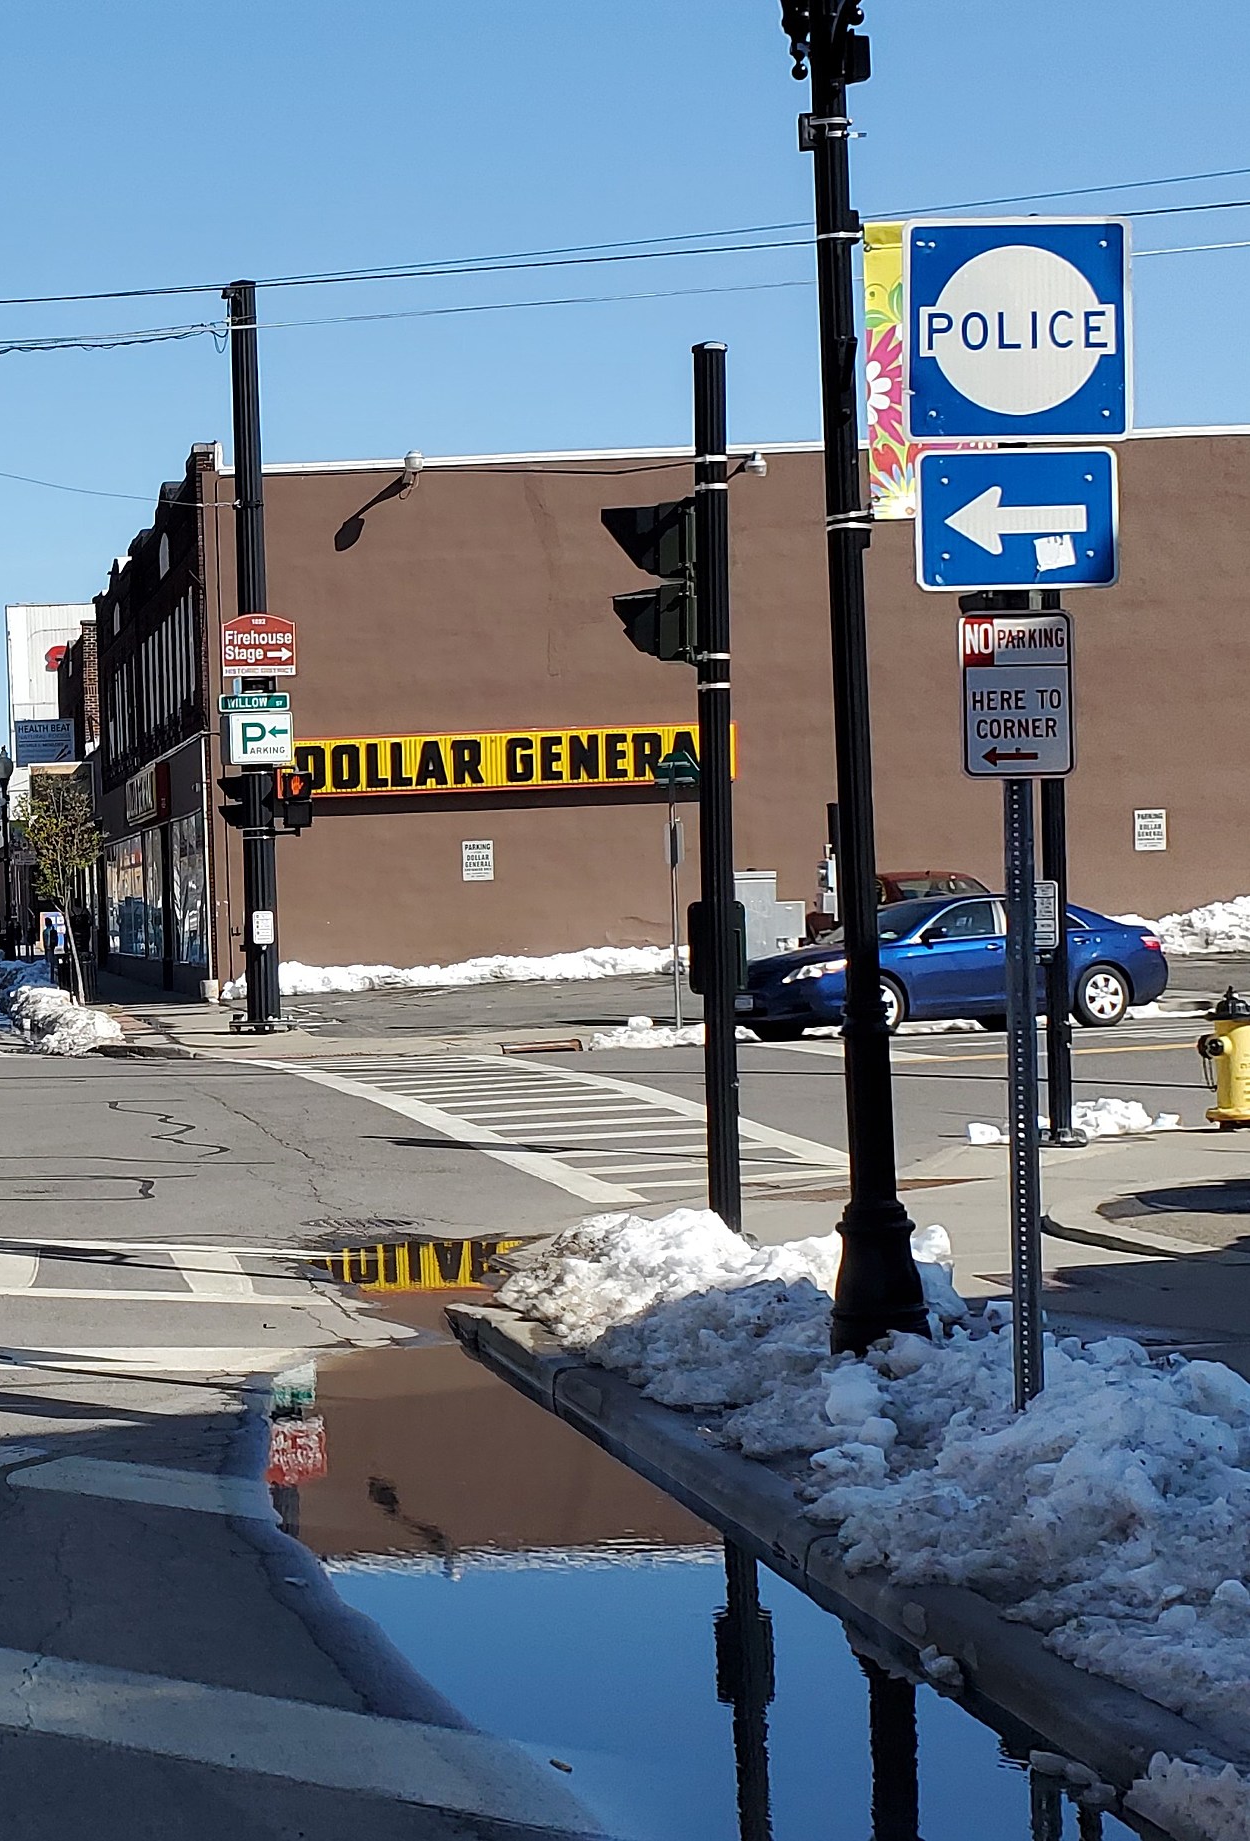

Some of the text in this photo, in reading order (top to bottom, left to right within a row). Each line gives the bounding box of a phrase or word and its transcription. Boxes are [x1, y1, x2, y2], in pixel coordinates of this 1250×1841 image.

[927, 310, 1108, 351] POLICE
[225, 630, 292, 645] Firehouse
[965, 623, 1065, 655] NO PARKING
[225, 646, 264, 663] Stage
[227, 697, 268, 708] WILLOW
[972, 688, 1062, 711] HERE TO
[18, 723, 71, 733] HEALTH BEAT
[976, 717, 1057, 739] CORNER
[294, 739, 485, 790] DOLLAR
[464, 843, 491, 851] PARKING
